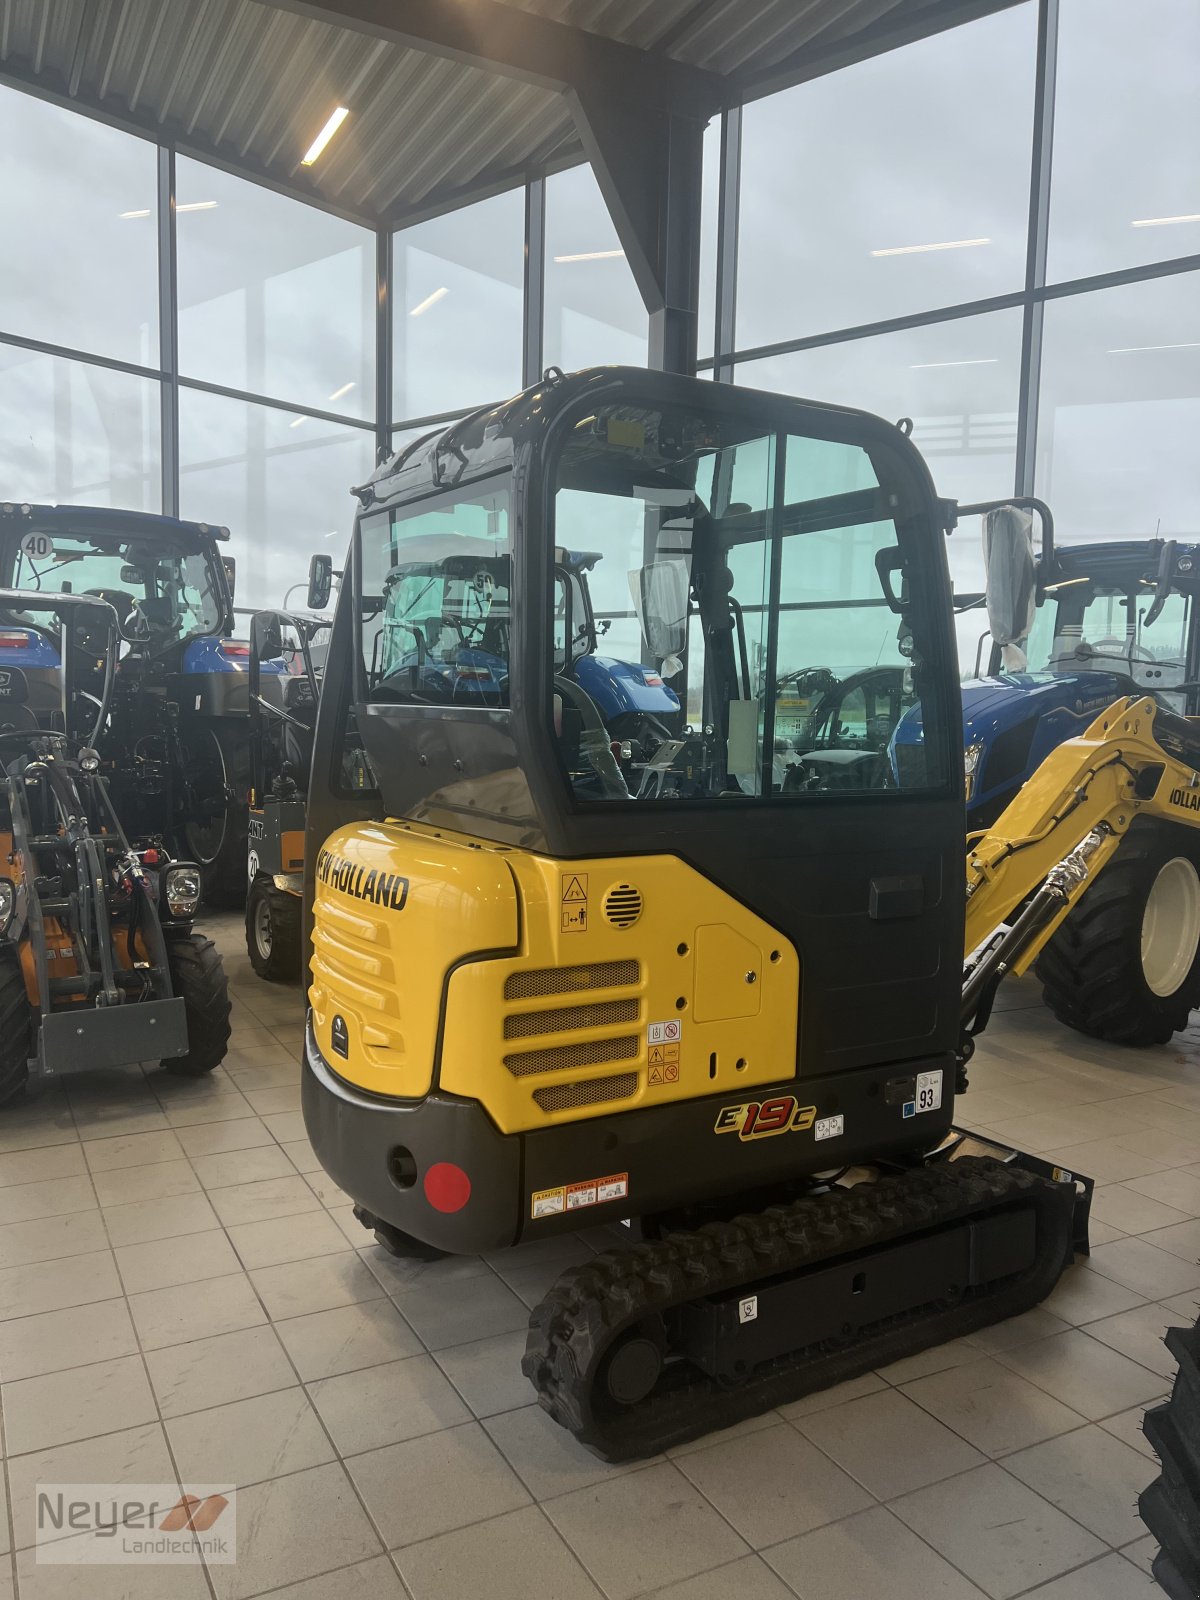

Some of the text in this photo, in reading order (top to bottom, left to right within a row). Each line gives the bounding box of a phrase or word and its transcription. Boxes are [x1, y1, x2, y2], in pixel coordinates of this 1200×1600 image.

[25, 536, 48, 555] 40
[330, 856, 410, 911] HOLLAND
[919, 1088, 934, 1109] 93
